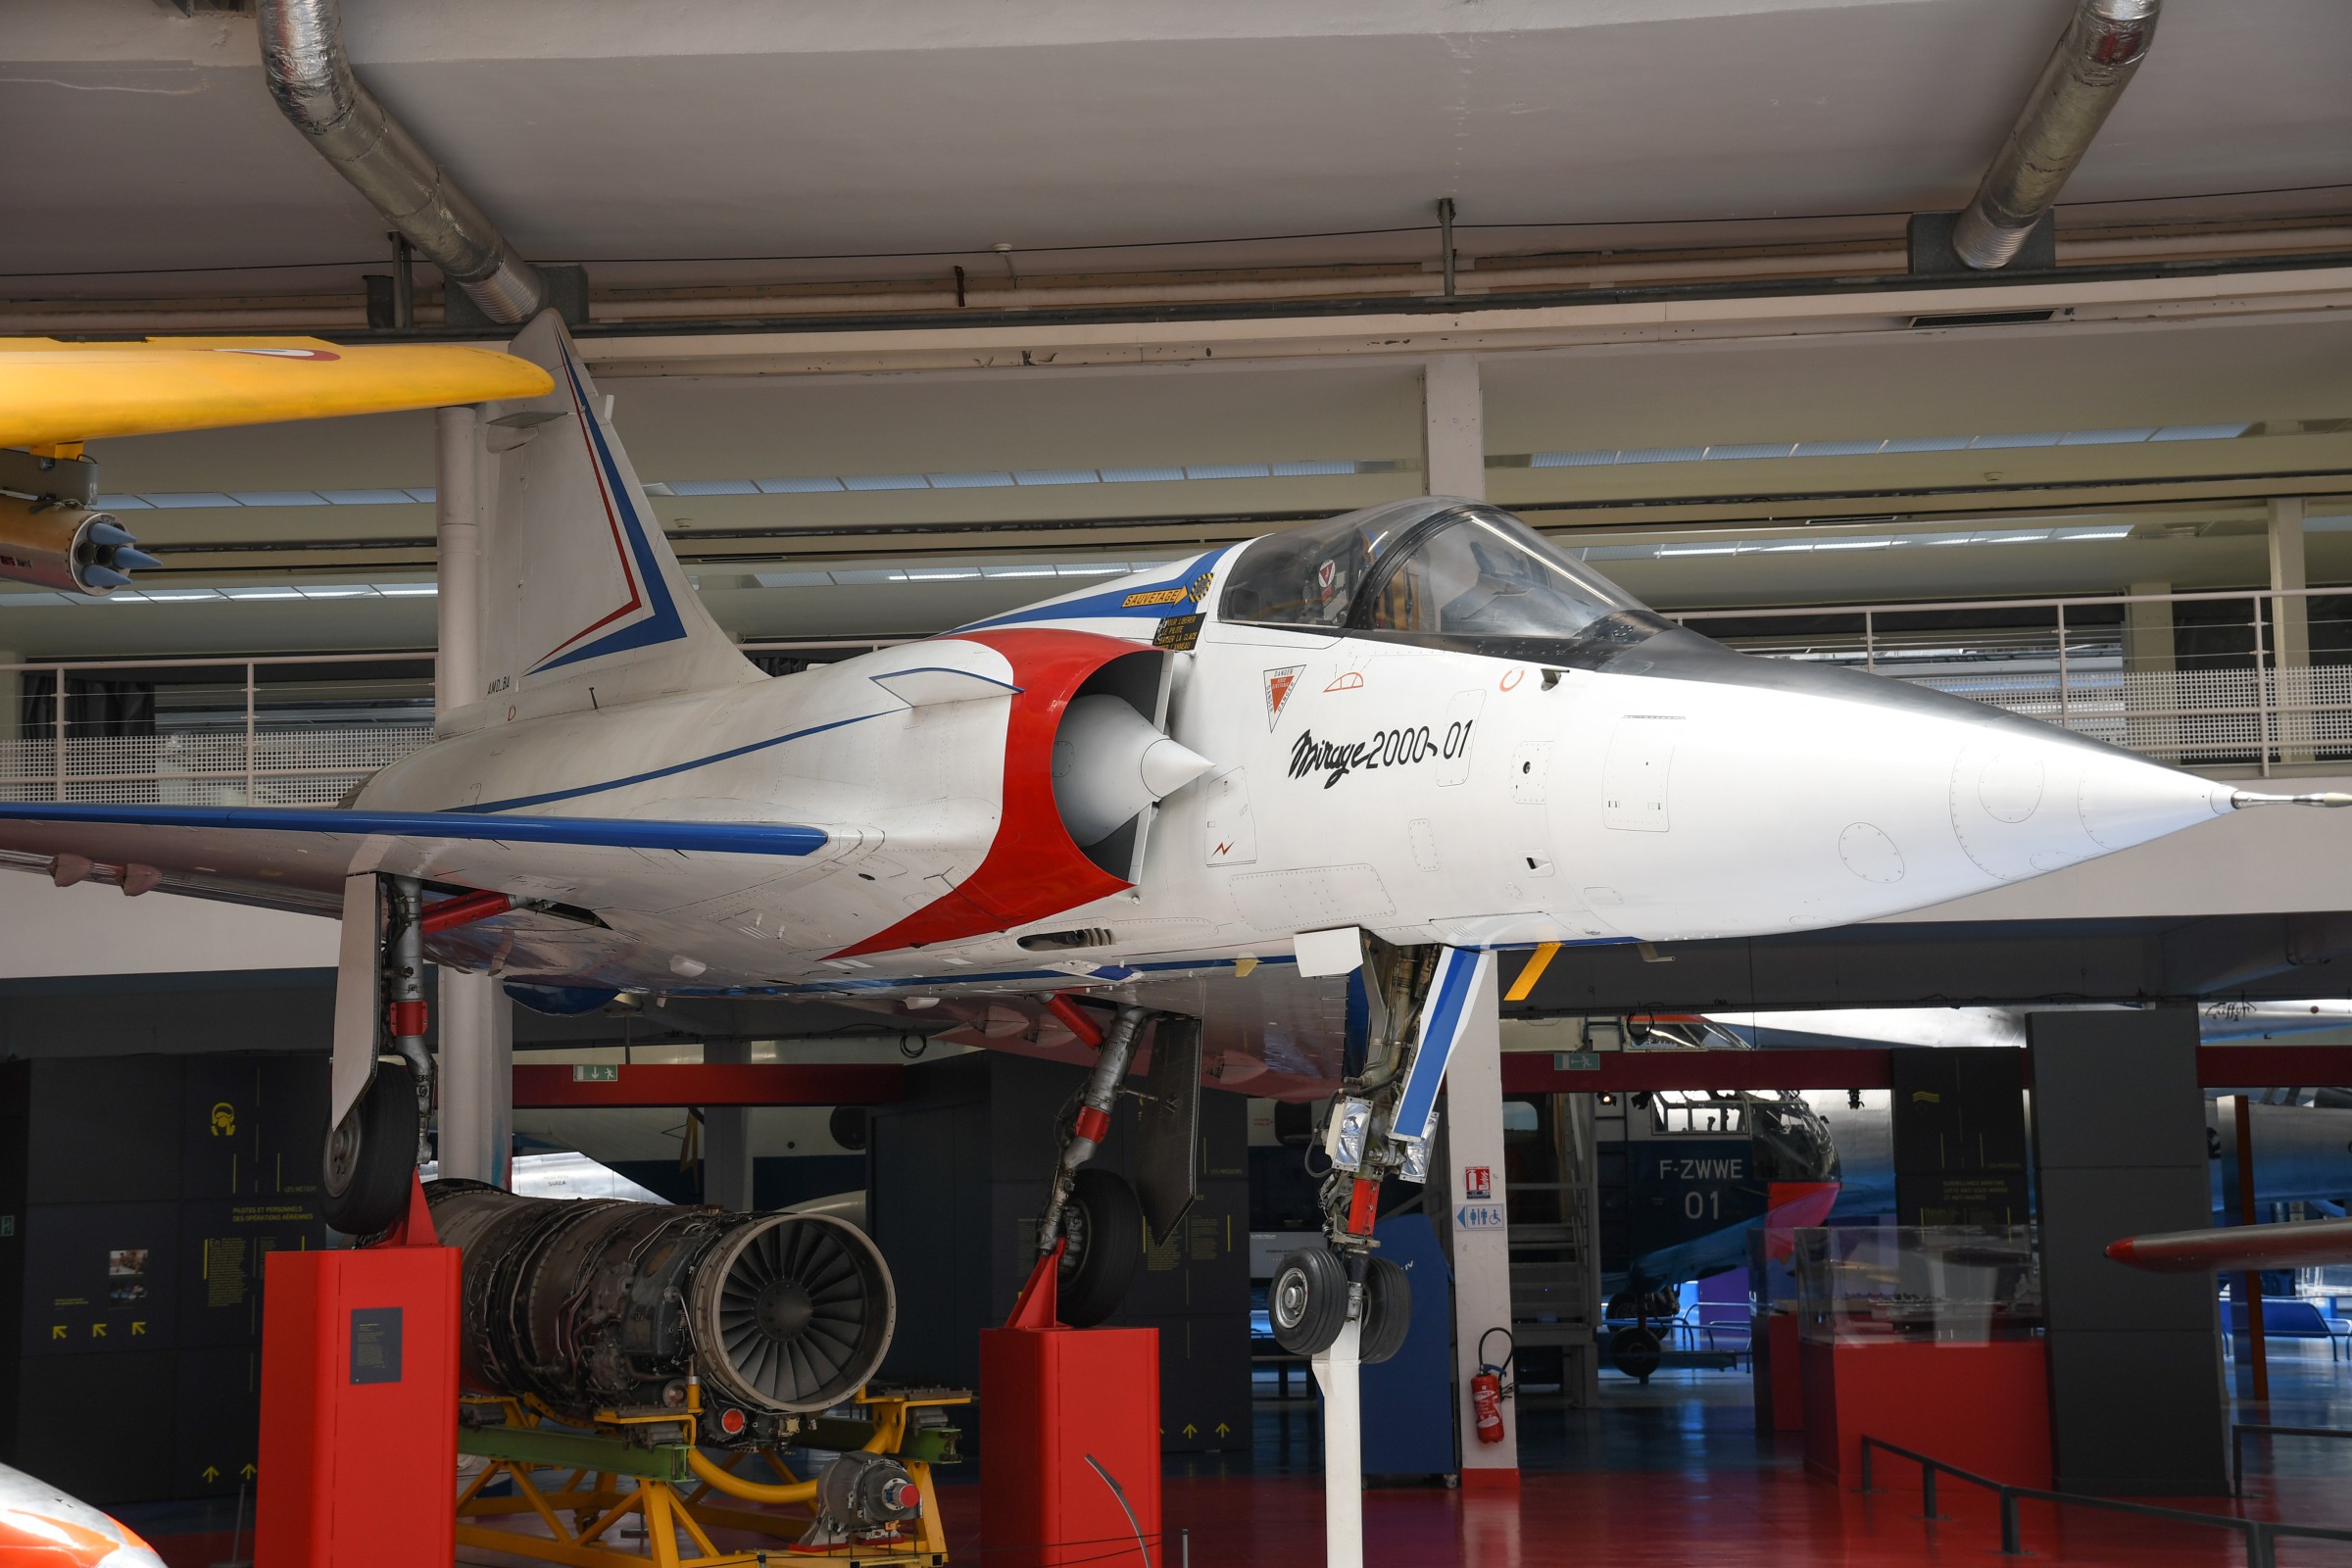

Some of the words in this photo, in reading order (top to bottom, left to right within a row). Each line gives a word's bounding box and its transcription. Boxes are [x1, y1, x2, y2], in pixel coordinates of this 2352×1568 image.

[1125, 590, 1178, 606] SAUVETAGE
[1274, 668, 1294, 677] DANGER
[1278, 682, 1295, 712] DANGER
[1288, 728, 1372, 790] Mirage
[1659, 1158, 1743, 1180] F-ZWWE
[1685, 1191, 1720, 1220] 01
